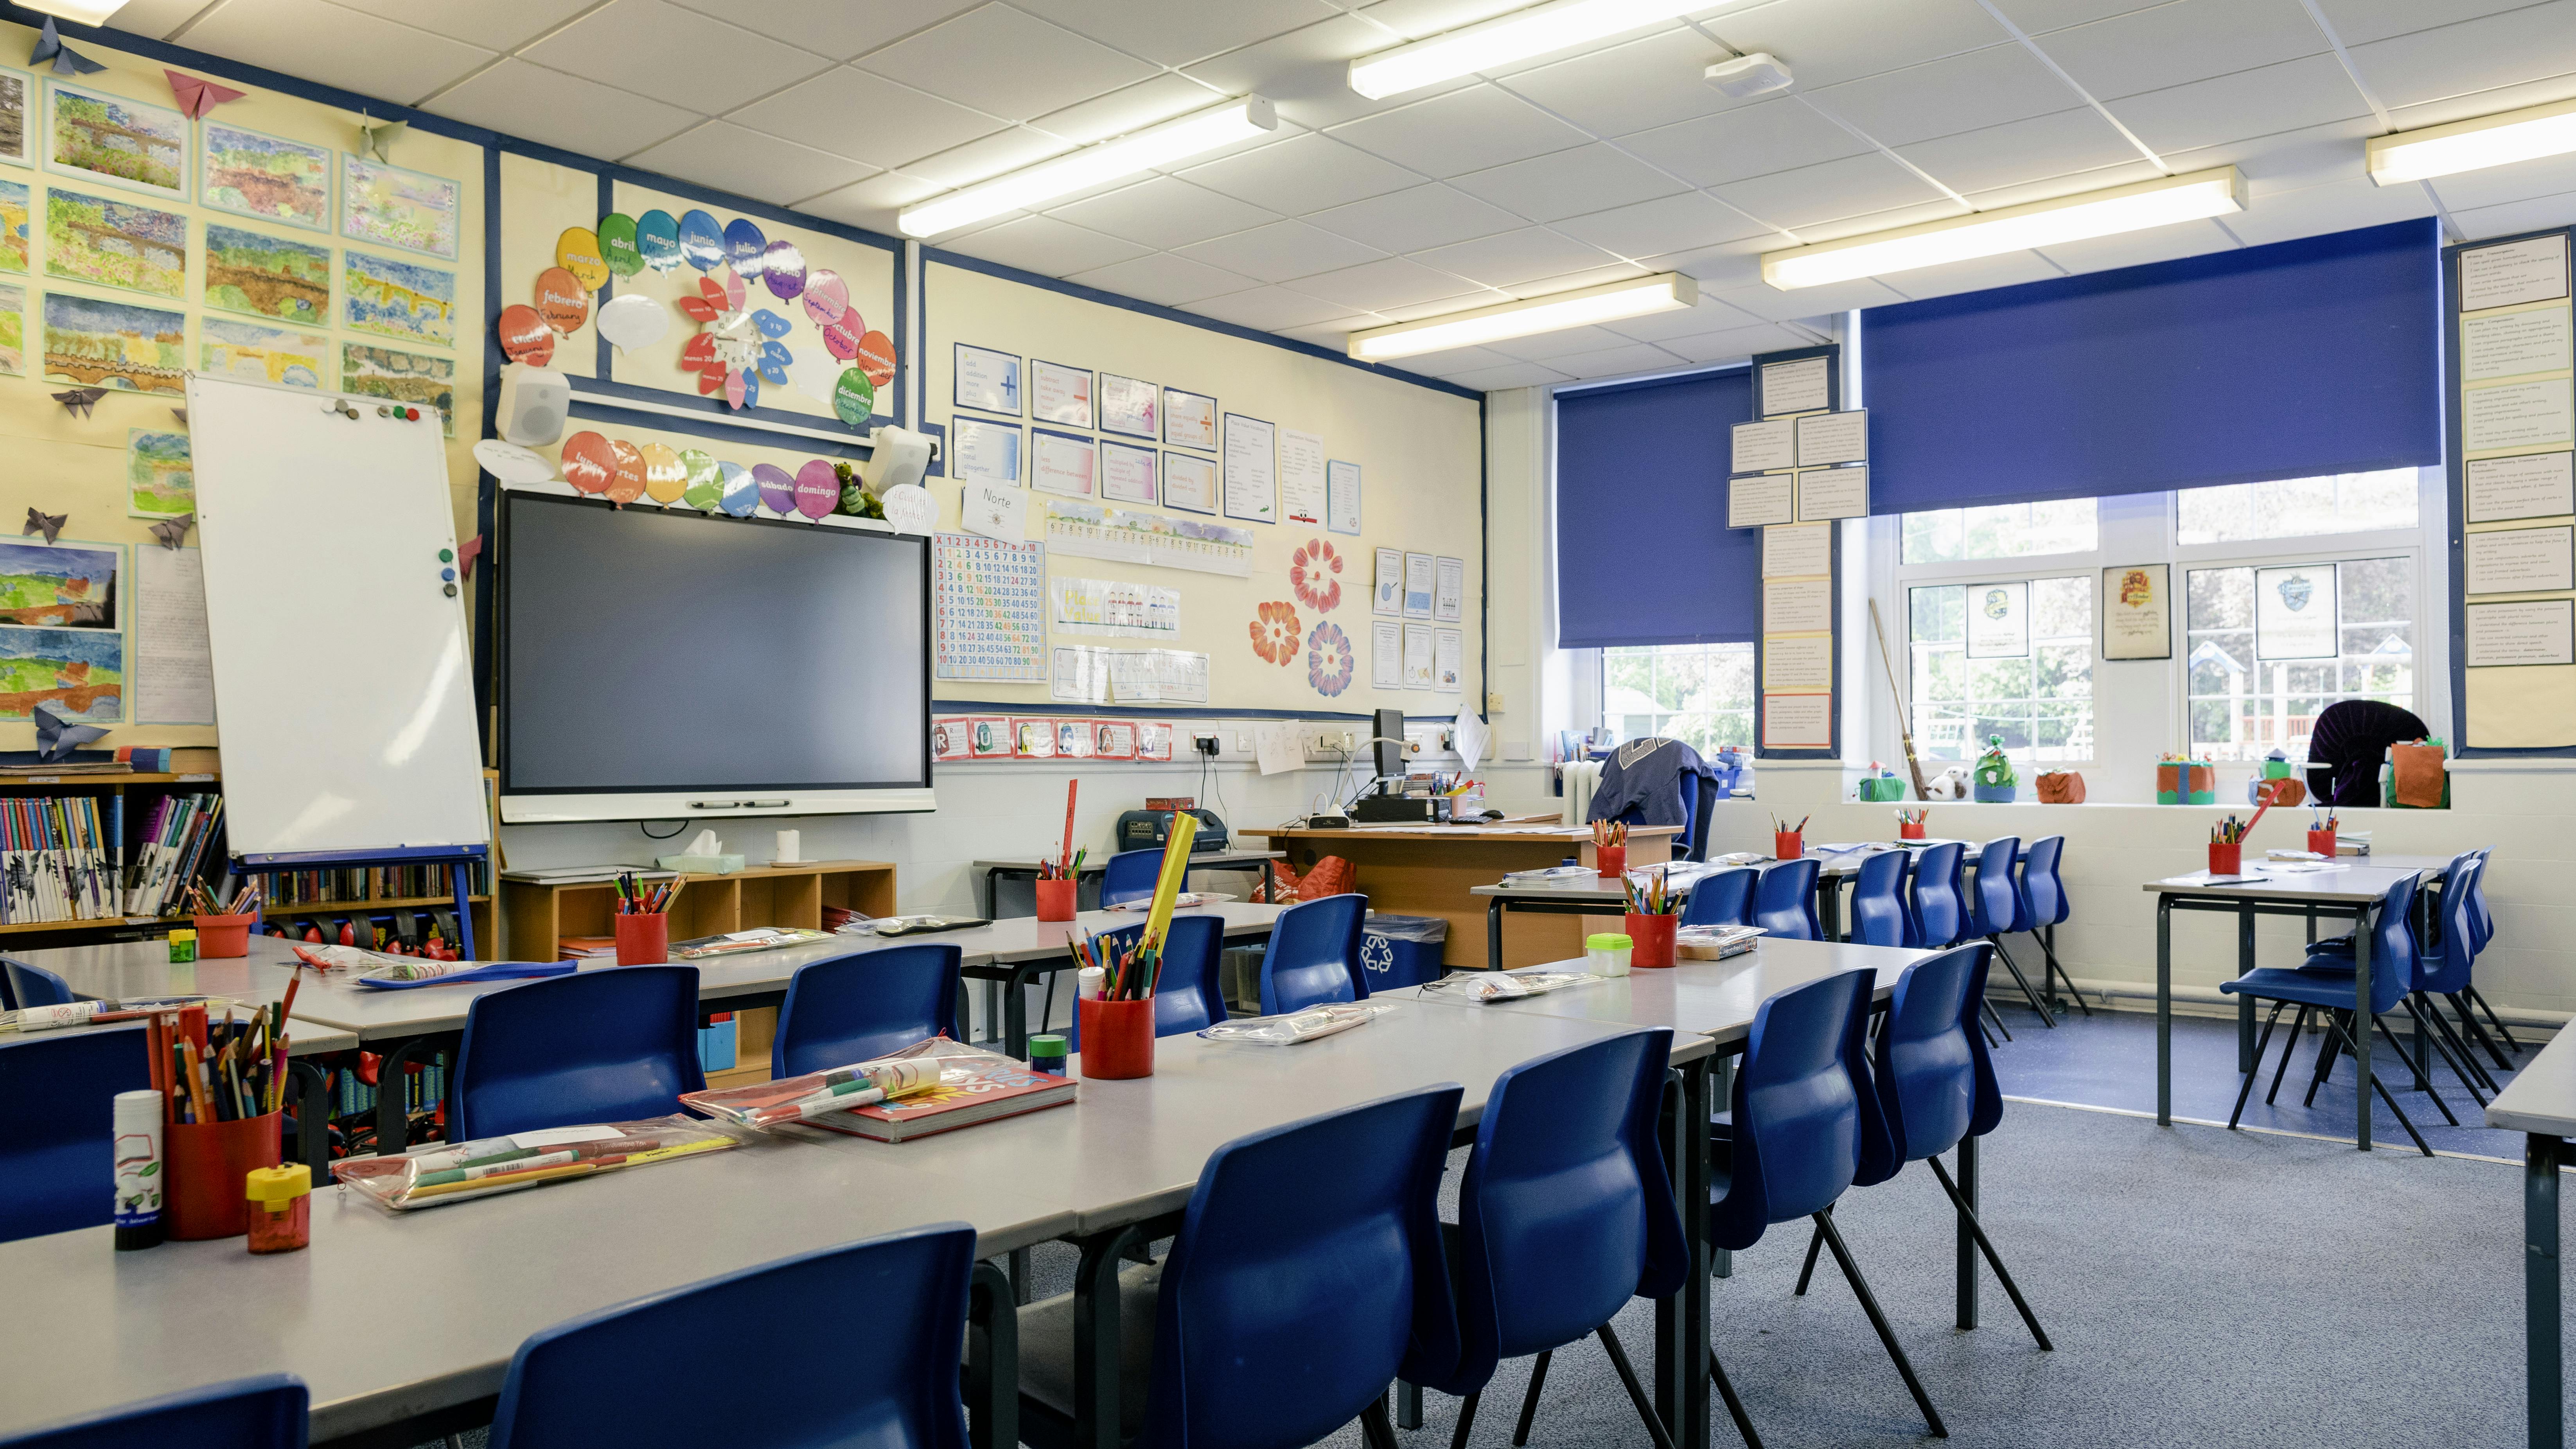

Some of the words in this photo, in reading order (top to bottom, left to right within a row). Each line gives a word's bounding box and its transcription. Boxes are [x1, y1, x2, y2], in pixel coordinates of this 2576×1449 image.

[611, 237, 635, 251] abril
[647, 233, 676, 249] mayo
[690, 232, 715, 247] junio
[735, 241, 756, 255] julio
[567, 253, 601, 266] marzo
[607, 248, 632, 266] April
[769, 265, 801, 278] agosto
[543, 289, 583, 309] febrero
[804, 293, 838, 319] September
[539, 309, 581, 324] February
[512, 333, 543, 344] enero
[824, 328, 853, 353] October
[859, 347, 896, 368] noviembre
[966, 371, 987, 379] addition
[1041, 375, 1060, 384] subtract
[838, 386, 871, 406] diciembre
[1053, 388, 1065, 396] away
[1250, 424, 1267, 433] Vocabulary
[1304, 436, 1320, 445] Vocabulary
[964, 463, 990, 472] altogether
[1041, 466, 1065, 475] difference
[1067, 470, 1087, 479] between
[617, 469, 639, 483] rtes
[761, 480, 793, 492] sábado
[798, 485, 836, 497] domingo
[984, 488, 1011, 508] Norte
[937, 536, 942, 544] X
[1065, 590, 1099, 605] Place
[1064, 607, 1101, 621] Value
[940, 655, 947, 664] 10
[949, 655, 956, 664] 10
[937, 734, 947, 749] R
[980, 731, 990, 745] U
[1103, 734, 1114, 747] A
